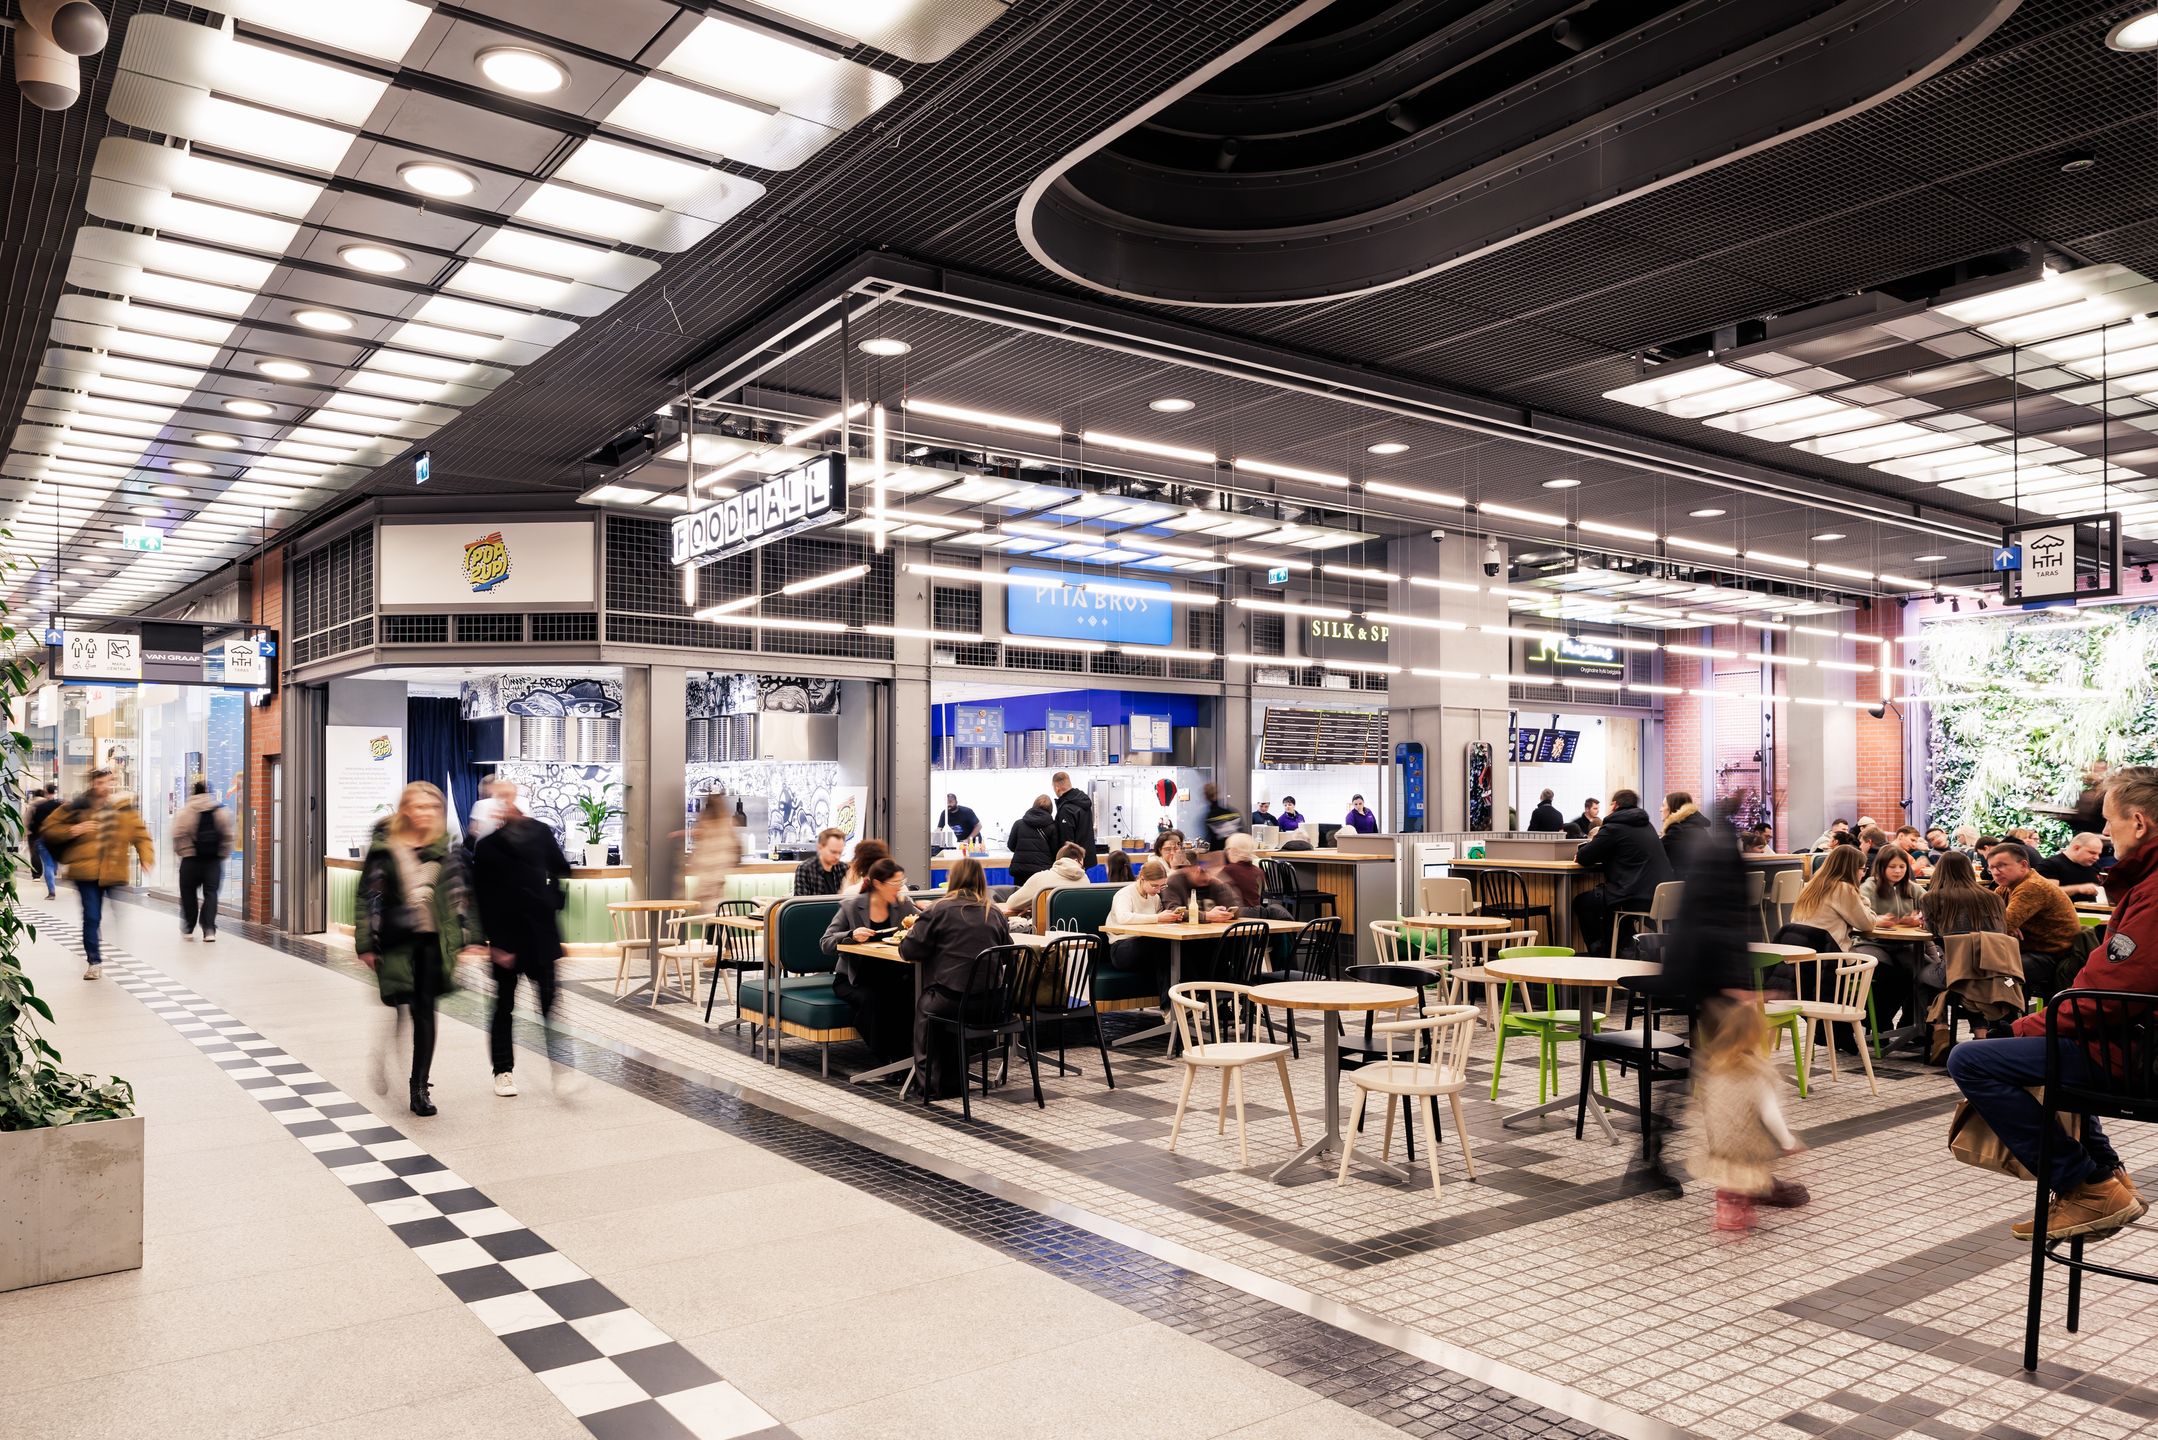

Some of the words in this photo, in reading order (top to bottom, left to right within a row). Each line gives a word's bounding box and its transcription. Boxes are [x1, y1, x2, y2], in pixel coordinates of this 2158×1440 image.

[676, 467, 826, 558] FOODHALL
[472, 542, 505, 567] POP
[470, 560, 504, 584] 2UP
[2036, 570, 2059, 578] TARAS
[1035, 585, 1088, 608] PITA
[1095, 591, 1148, 613] BROS
[1312, 619, 1355, 640] SILK
[1358, 627, 1367, 641] &
